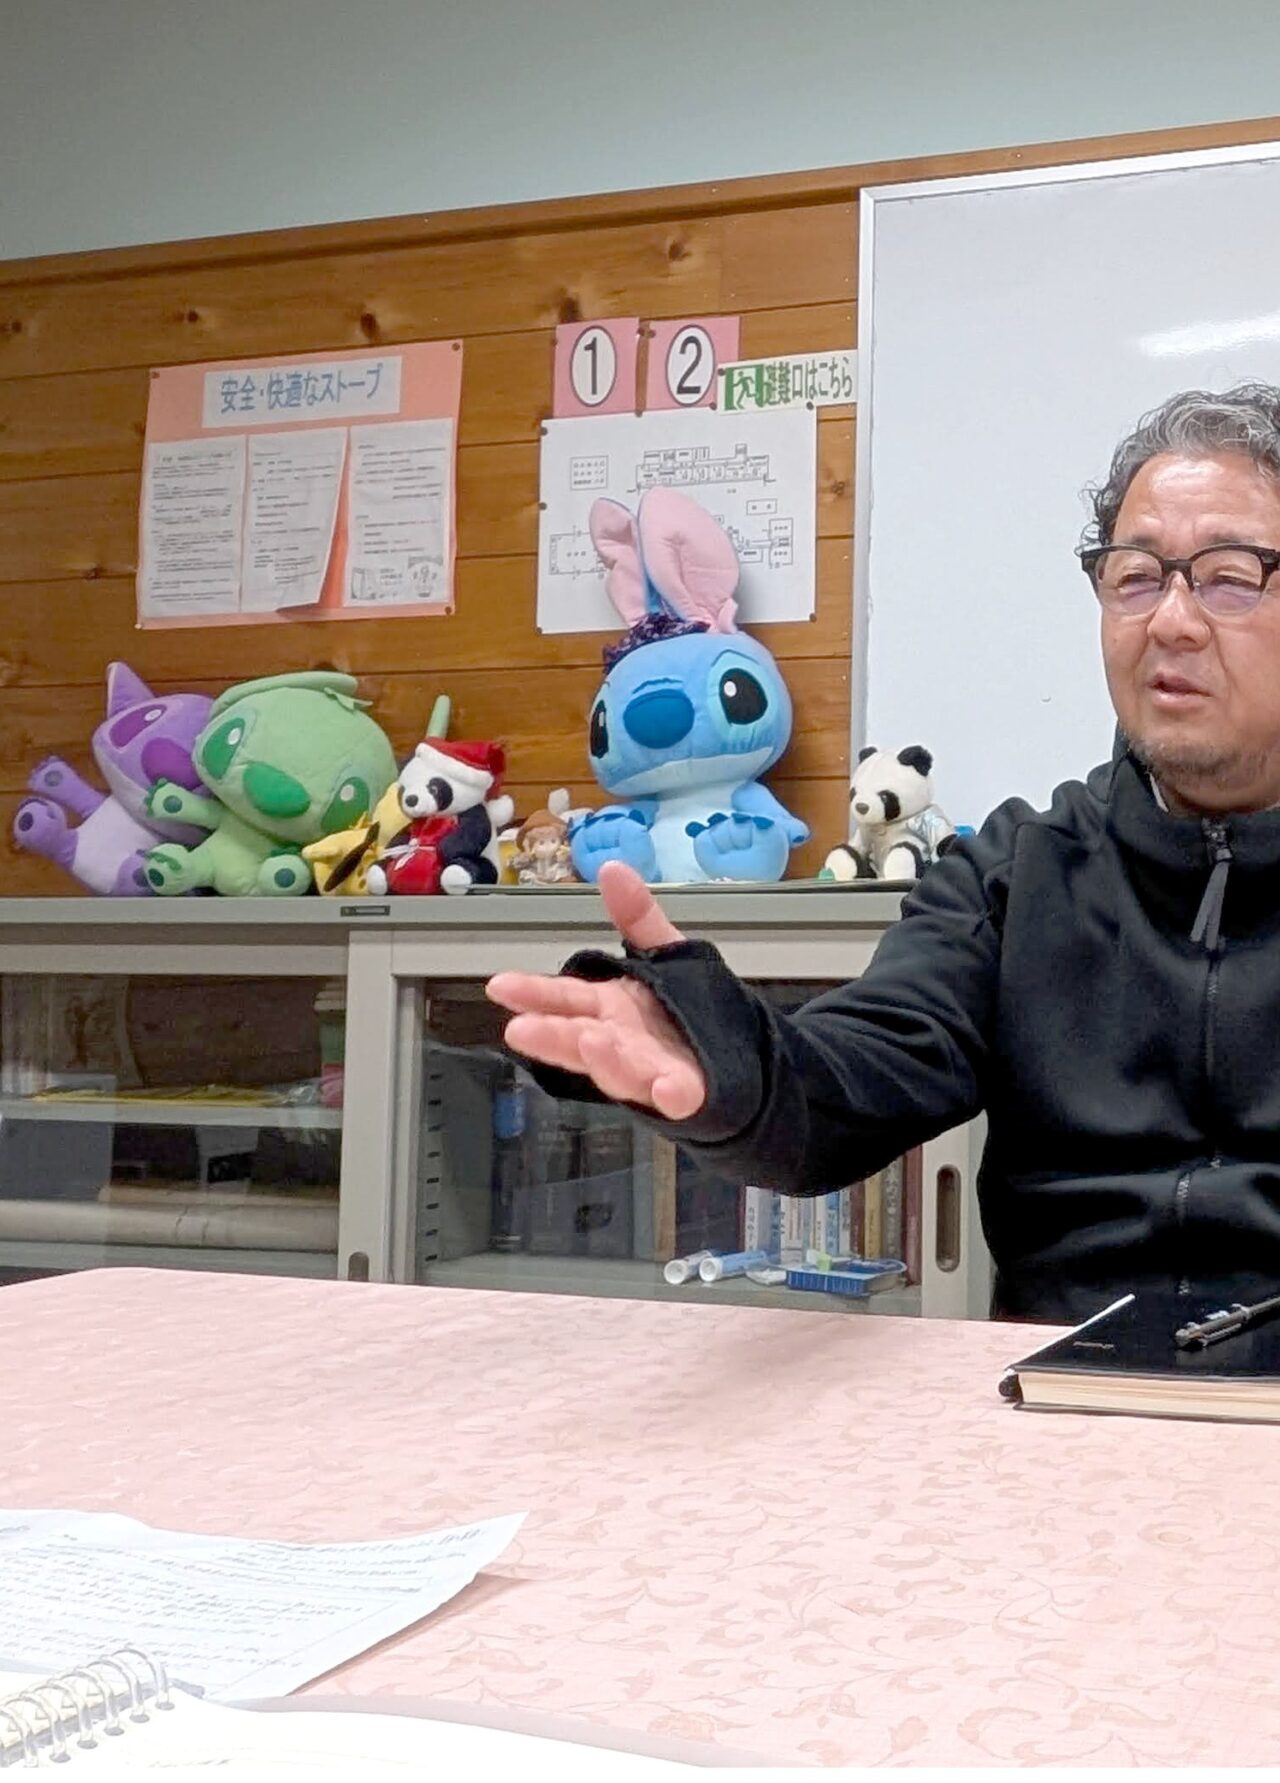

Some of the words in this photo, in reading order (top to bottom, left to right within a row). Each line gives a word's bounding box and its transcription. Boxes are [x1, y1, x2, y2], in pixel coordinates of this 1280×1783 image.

[765, 357, 853, 405] 避難口はこちら
